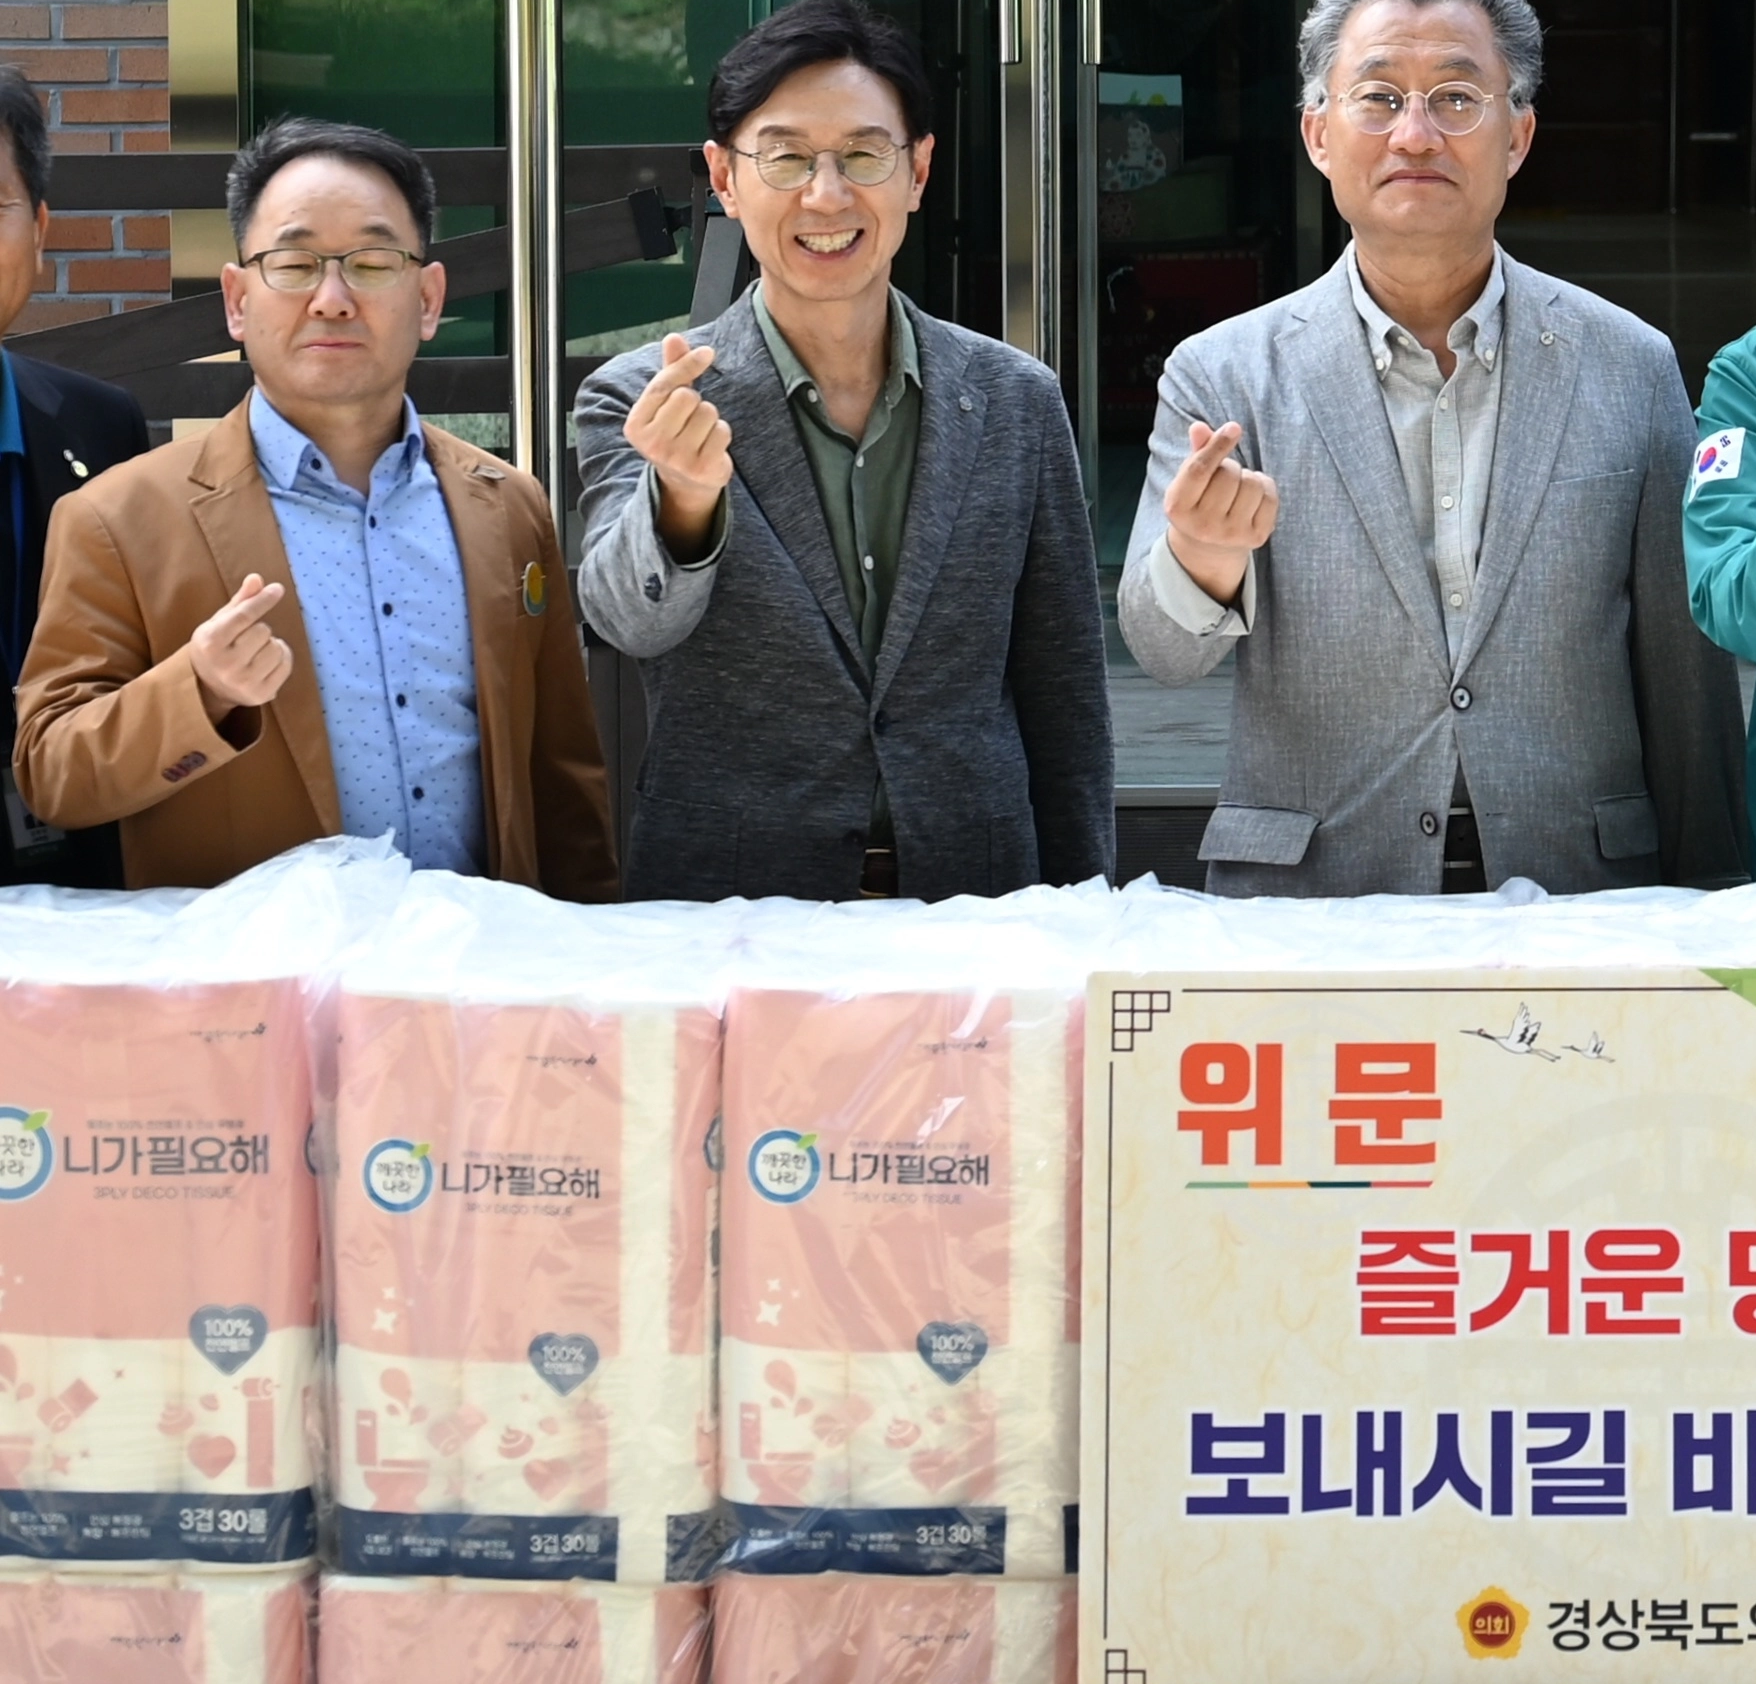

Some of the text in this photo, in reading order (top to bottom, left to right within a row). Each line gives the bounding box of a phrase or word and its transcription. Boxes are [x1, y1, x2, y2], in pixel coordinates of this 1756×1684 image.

[63, 1134, 271, 1177] 니가필요해
[441, 1162, 601, 1199] 니가필요해
[768, 1171, 798, 1185] 나라
[829, 1152, 990, 1187] 니가필요해
[132, 1185, 179, 1200] DECO
[1357, 1228, 1685, 1336] 즐거운
[203, 1318, 254, 1337] 100%
[541, 1345, 586, 1362] 100%
[930, 1334, 975, 1352] 100%
[1186, 1408, 1628, 1517] 보내시길
[179, 1508, 214, 1532] 3겹
[529, 1533, 559, 1554] 3겹
[916, 1525, 945, 1545] 3겹
[1474, 1613, 1510, 1637] 의회
